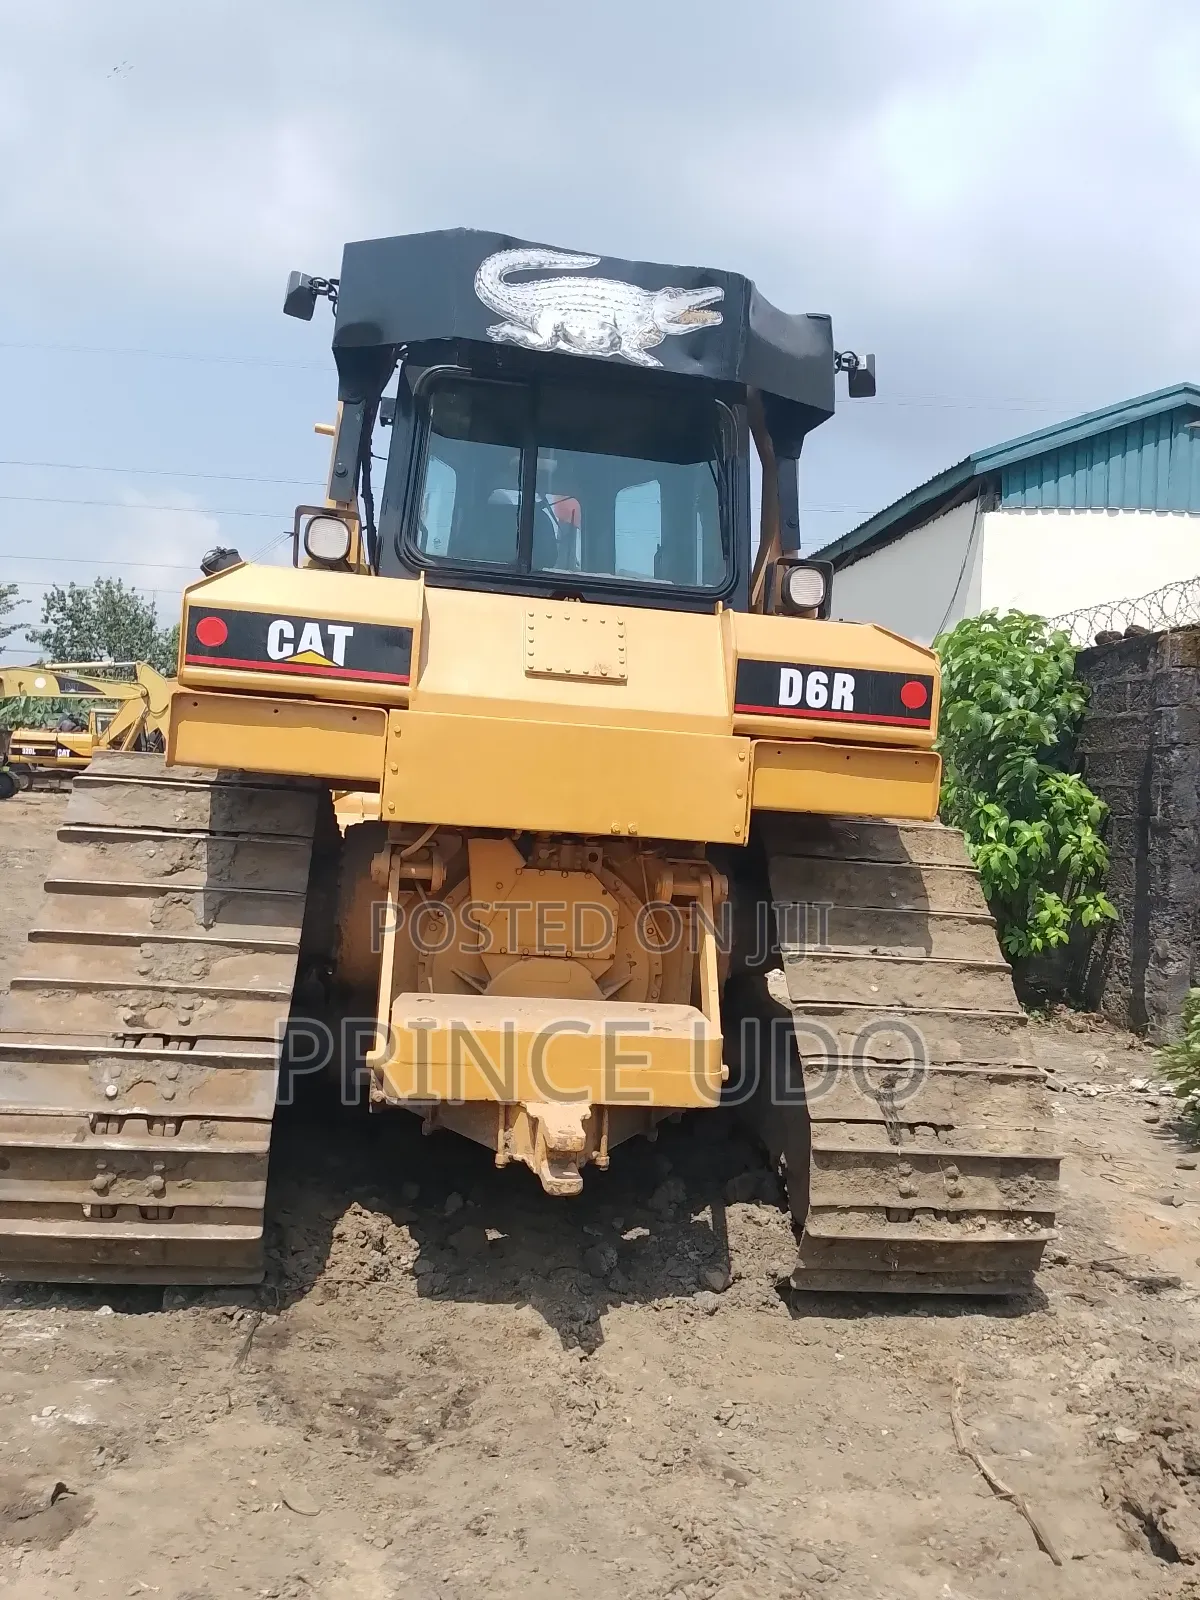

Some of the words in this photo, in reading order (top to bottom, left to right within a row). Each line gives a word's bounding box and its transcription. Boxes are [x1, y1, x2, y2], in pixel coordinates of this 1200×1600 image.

[267, 619, 354, 667] CAT
[778, 667, 856, 711] D6R
[57, 749, 71, 757] CAT
